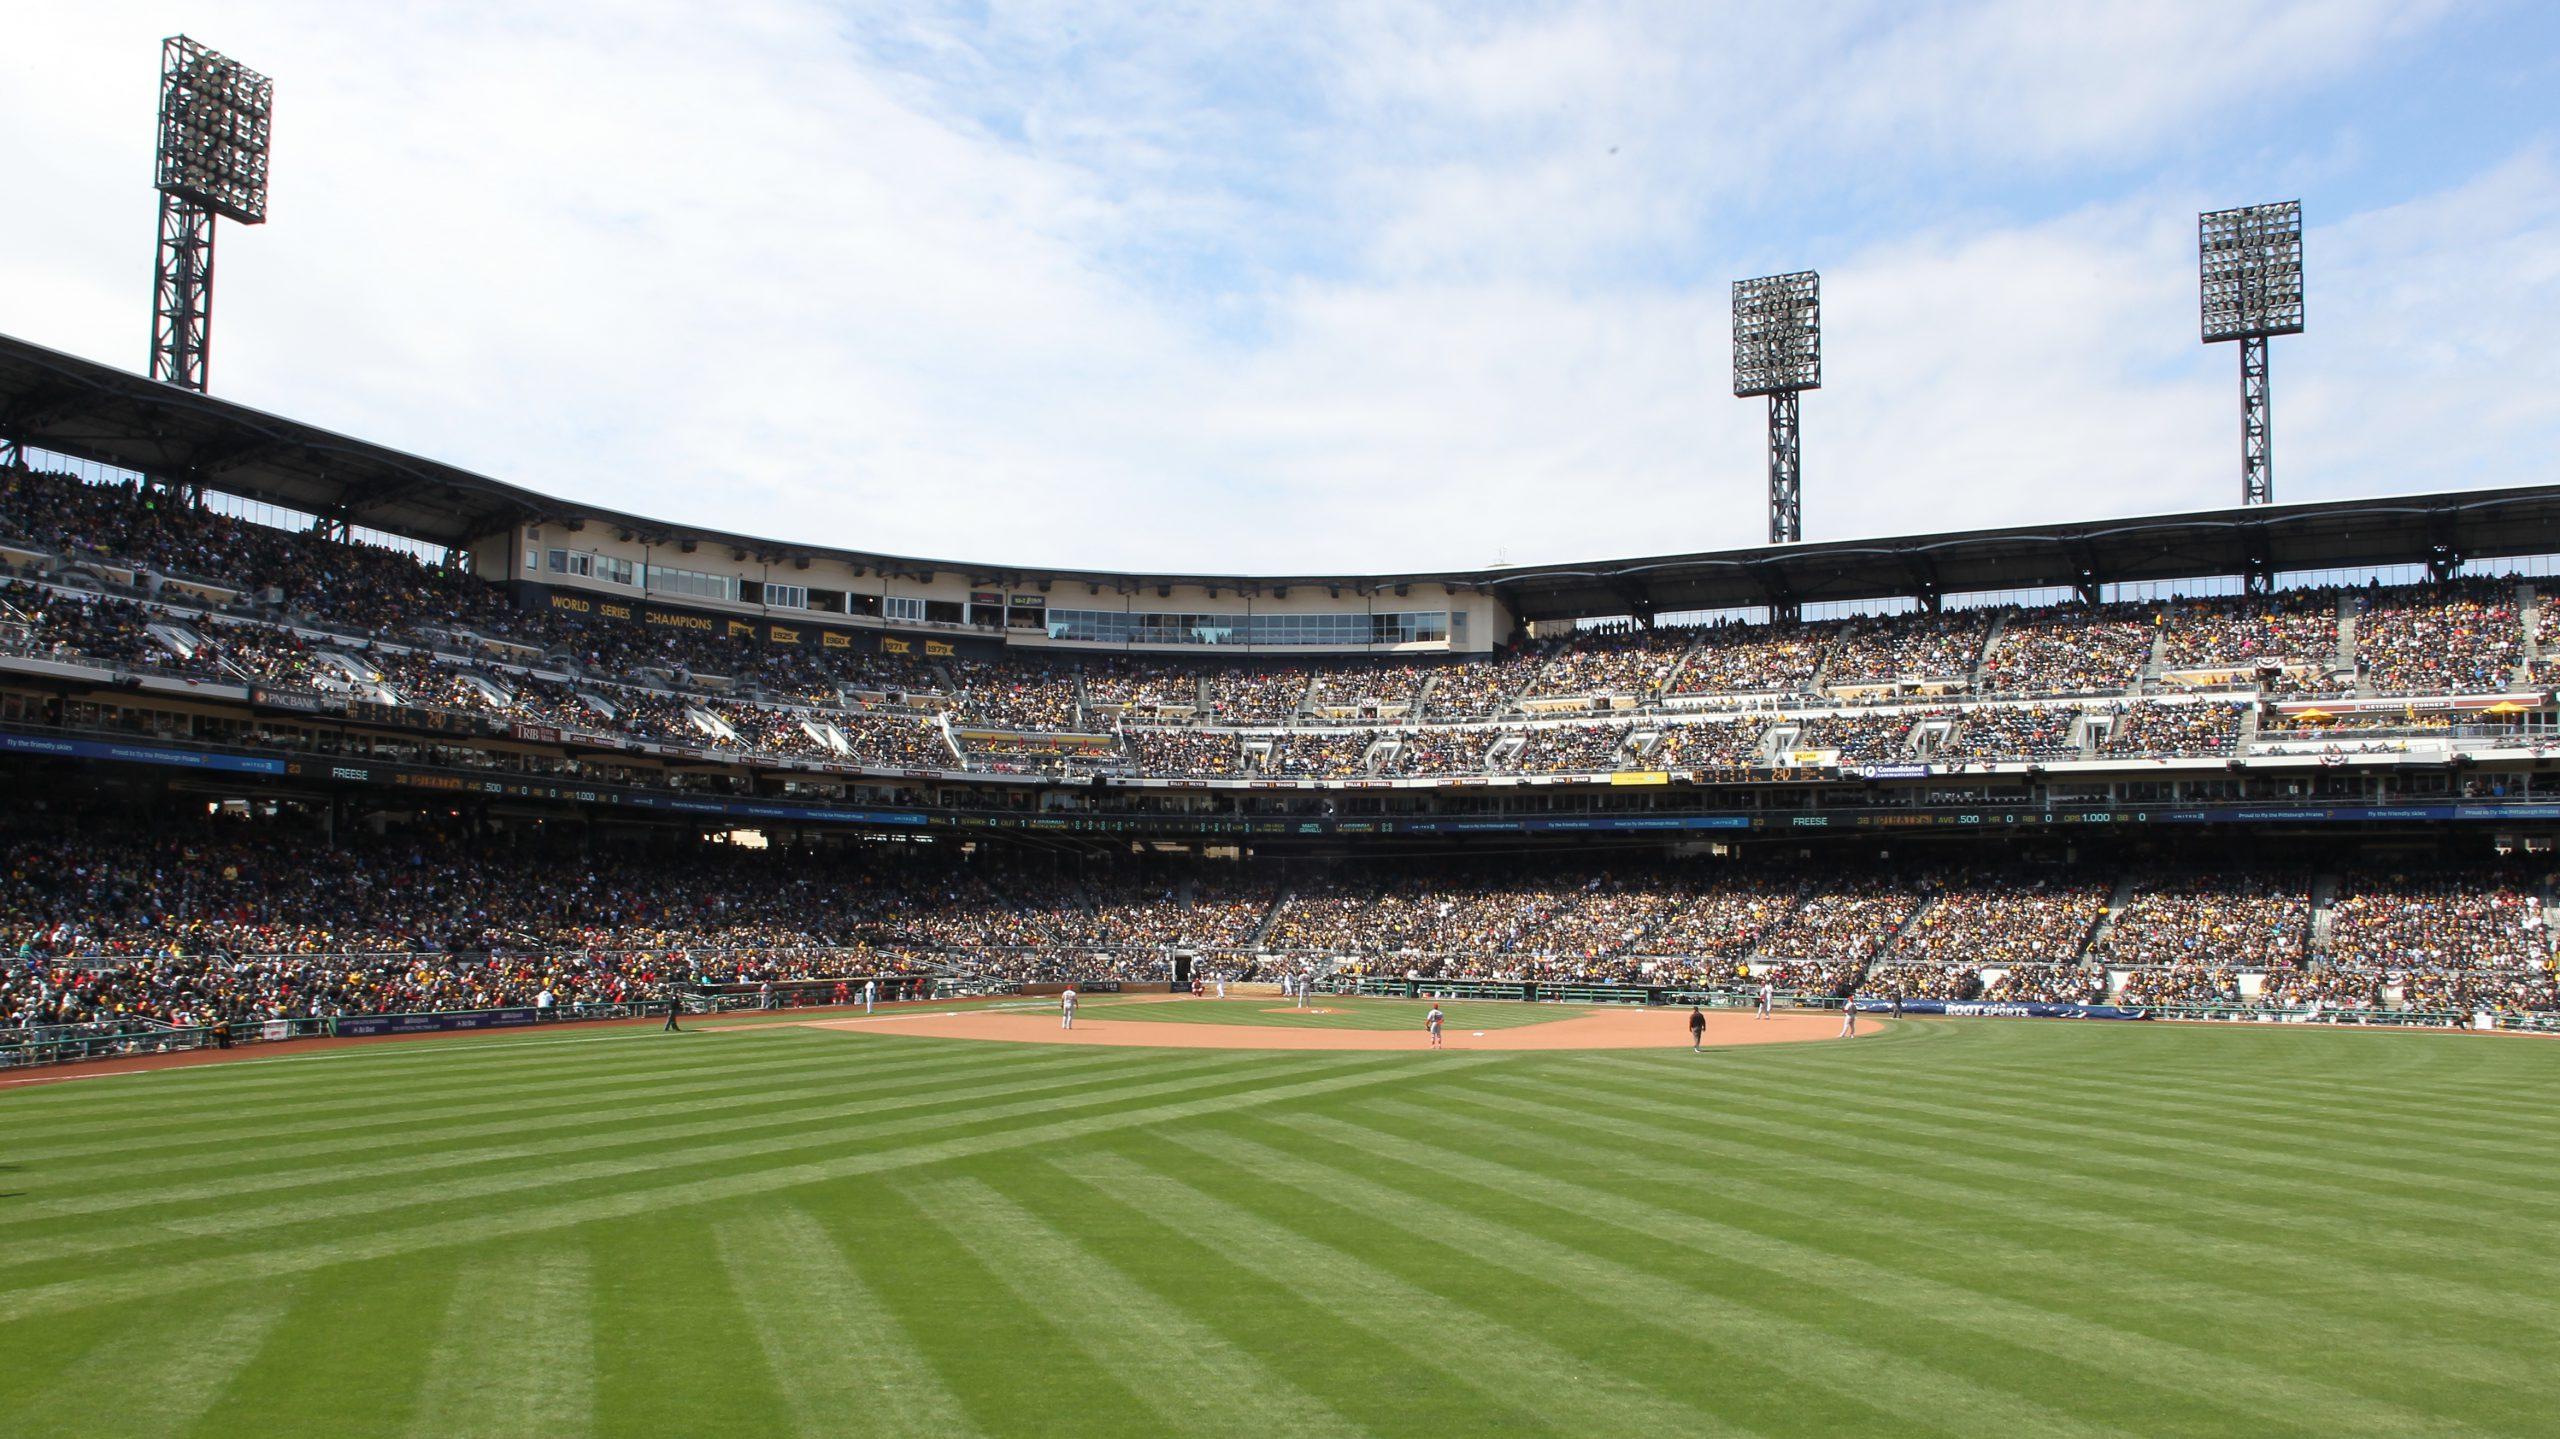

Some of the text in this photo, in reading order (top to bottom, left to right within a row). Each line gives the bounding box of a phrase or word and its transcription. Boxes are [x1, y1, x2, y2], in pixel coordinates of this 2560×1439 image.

[552, 596, 712, 630] WORLD SERIES CHAMPIONS
[773, 632, 793, 640] 1925
[825, 636, 845, 645] 1960
[927, 645, 948, 654] 1979
[268, 693, 316, 709] PNC BANK
[516, 724, 539, 740] TRIB
[30, 741, 55, 750] friendly
[56, 743, 73, 751] skies
[1771, 768, 1791, 782] 2:47
[1877, 765, 1924, 773] Consolidated
[333, 767, 368, 780] FREESE
[484, 782, 501, 792] .500
[521, 786, 527, 795] 0
[550, 789, 556, 797] 0
[576, 791, 595, 801] 1.000
[612, 795, 618, 803] 0
[950, 817, 956, 825] 1
[989, 818, 997, 826] 0
[1020, 819, 1026, 827] 1
[1753, 818, 1764, 826] 23
[1793, 817, 1828, 826] FREESE
[1958, 815, 1979, 824] .500
[2006, 815, 2013, 823] 0
[2045, 814, 2052, 822] 0
[2064, 814, 2080, 822] OPS
[2081, 813, 2110, 822] 1.000
[2138, 813, 2146, 821] 0
[1945, 1004, 2029, 1017] ROOT SPORTS
